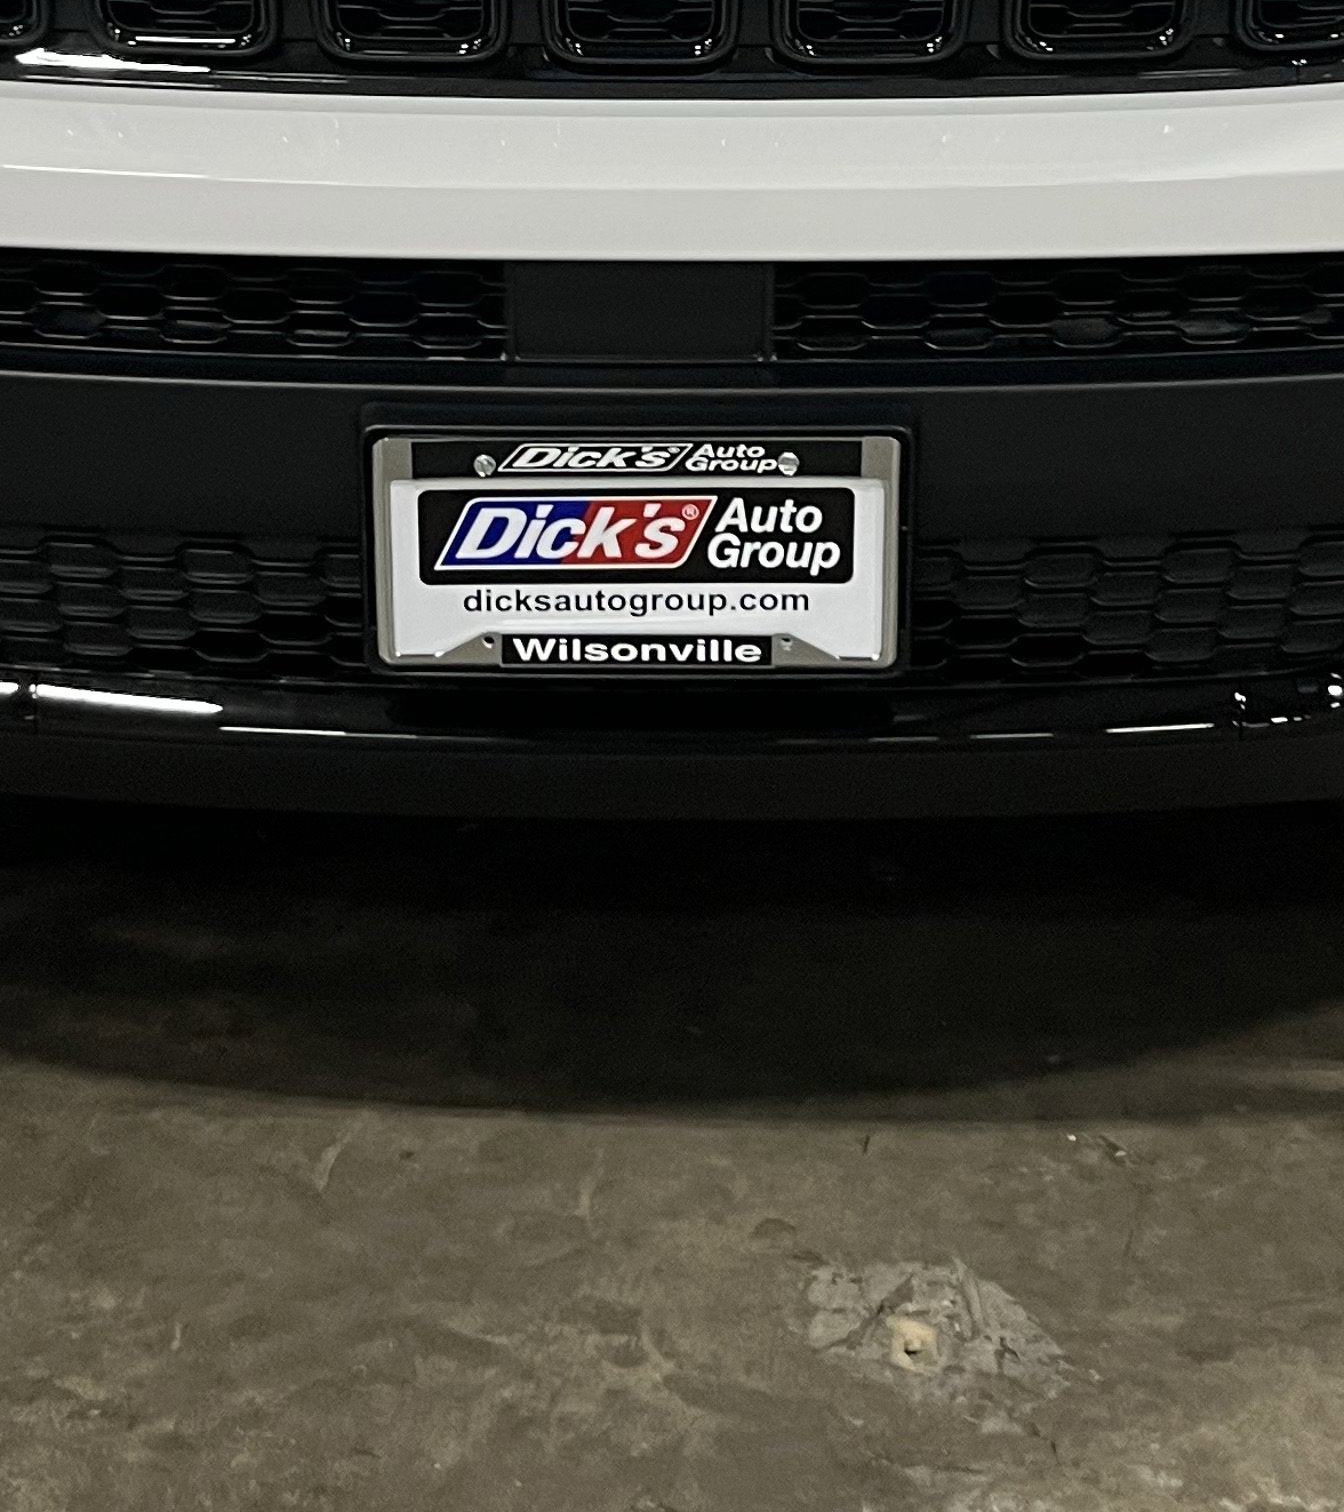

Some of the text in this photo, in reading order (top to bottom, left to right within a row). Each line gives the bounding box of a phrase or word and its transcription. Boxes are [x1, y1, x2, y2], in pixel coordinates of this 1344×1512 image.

[686, 456, 777, 473] Group
[692, 444, 765, 459] Auto
[714, 497, 823, 534] Auto
[707, 533, 841, 576] Group
[463, 590, 810, 617] dicksautogroup.com
[512, 637, 762, 662] Wilsonville
